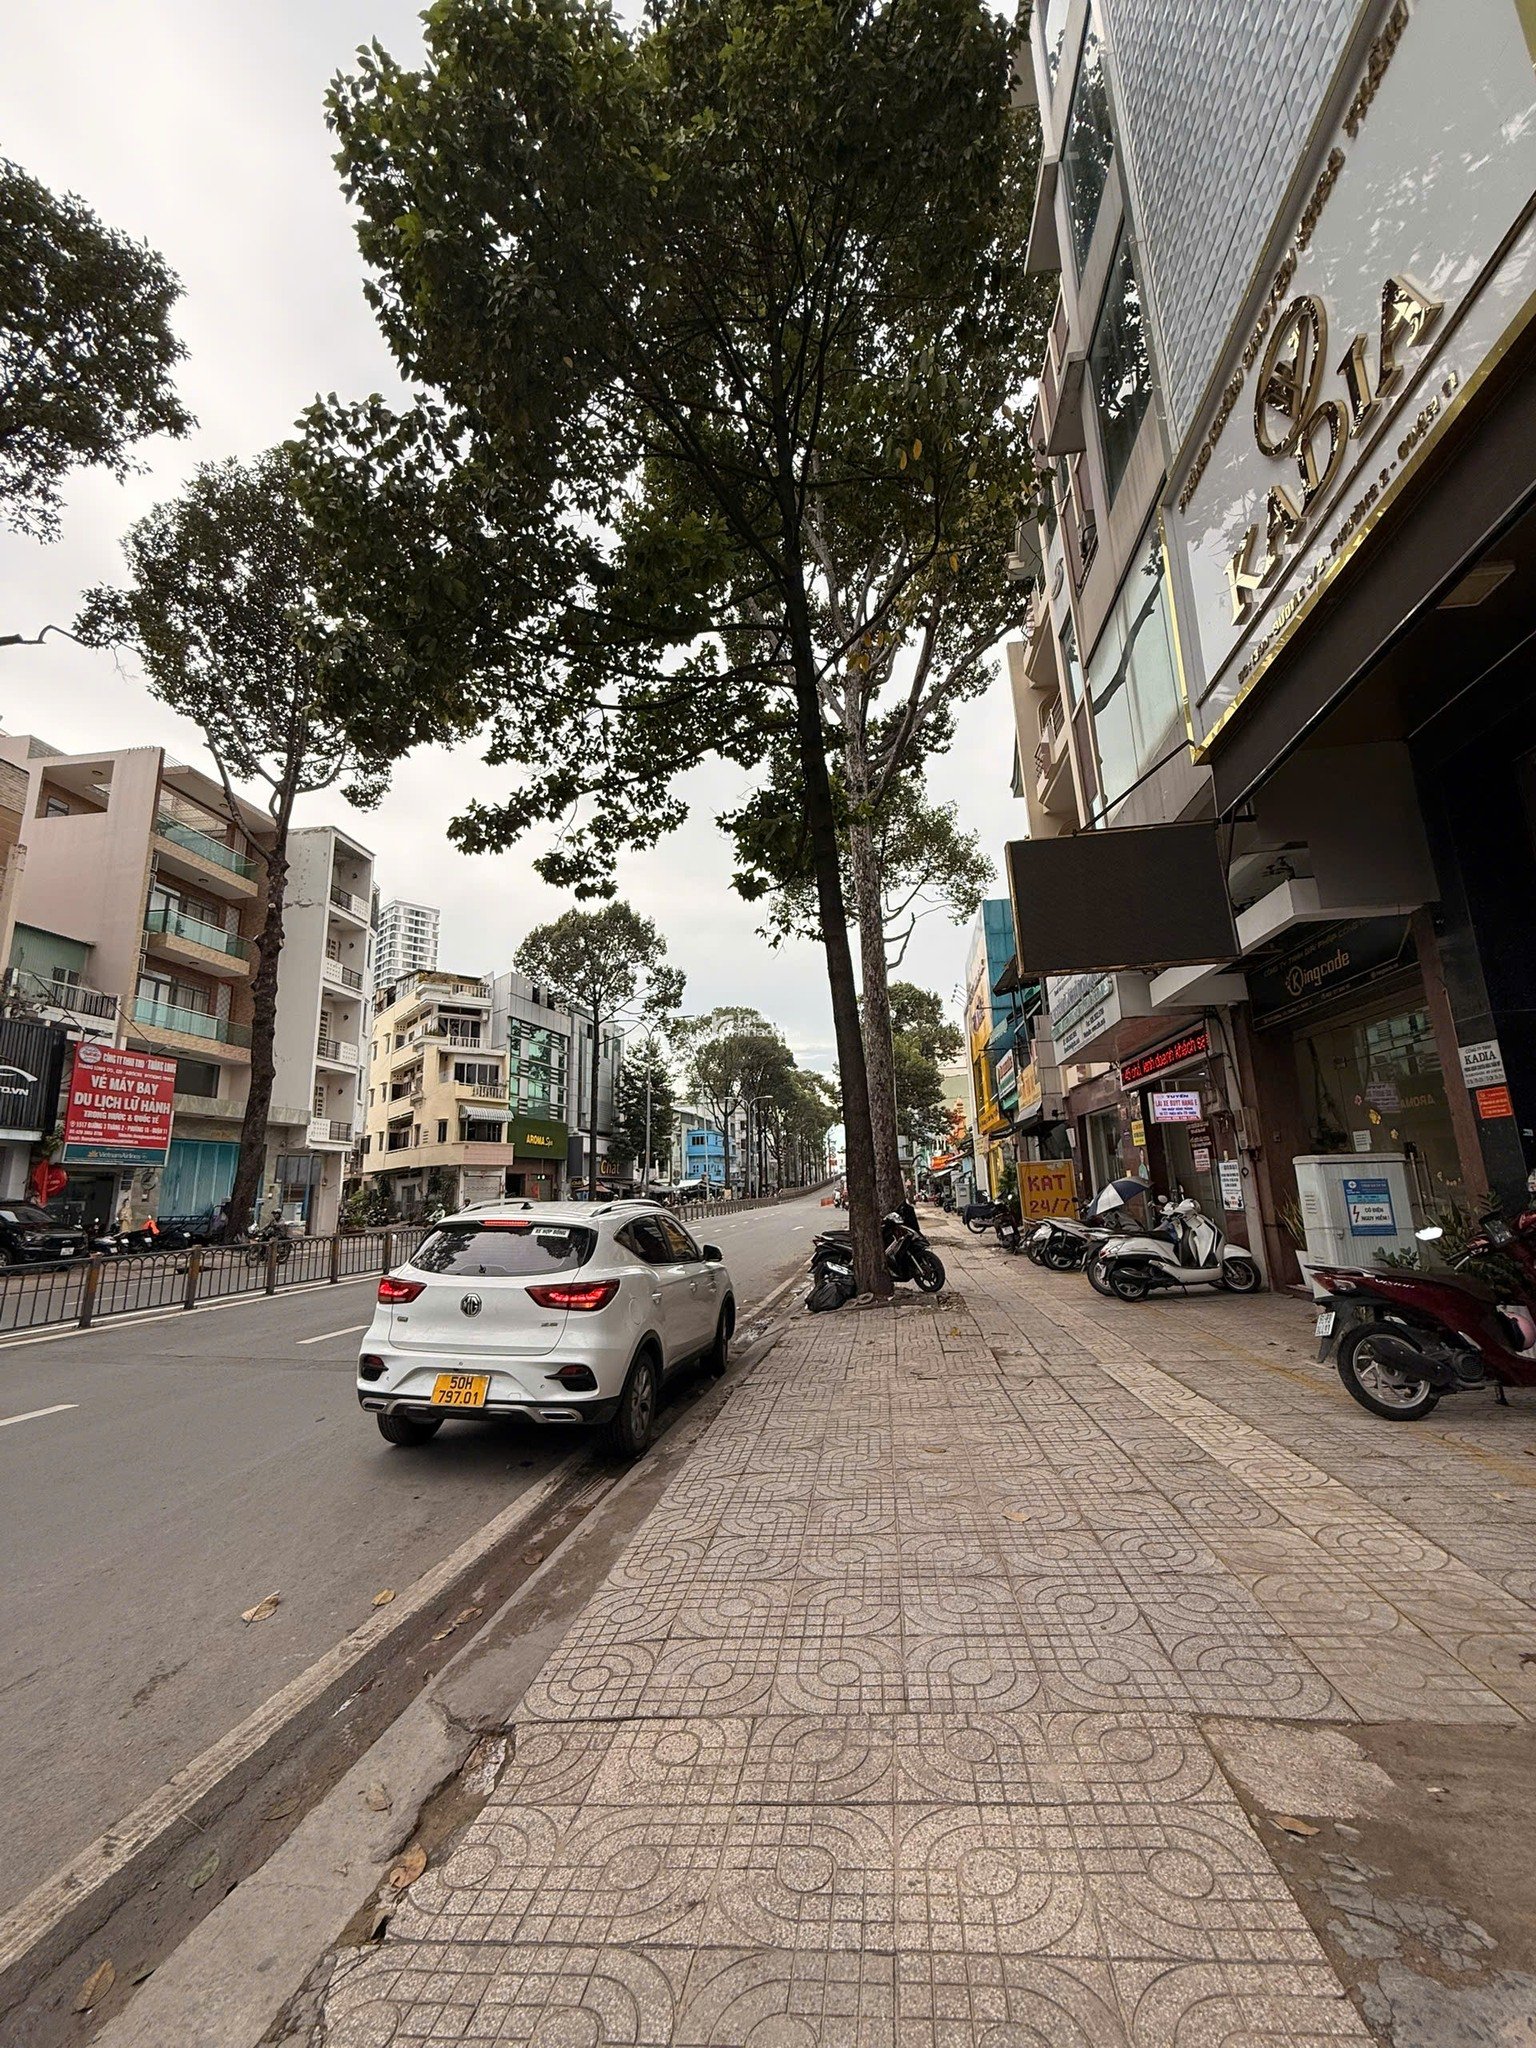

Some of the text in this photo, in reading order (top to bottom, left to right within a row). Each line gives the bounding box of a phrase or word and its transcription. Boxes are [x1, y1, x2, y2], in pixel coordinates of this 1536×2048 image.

[1464, 1050, 1497, 1065] KADIA
[91, 1073, 159, 1095] VÉ MÁY BAY
[74, 1091, 92, 1105] DU
[94, 1094, 121, 1111] LỊCH
[140, 1096, 171, 1114] HÀNH
[1027, 1174, 1066, 1192] KAT
[1030, 1197, 1070, 1214] 24/7
[450, 1376, 474, 1390] 50H
[439, 1390, 479, 1405] 797.01
